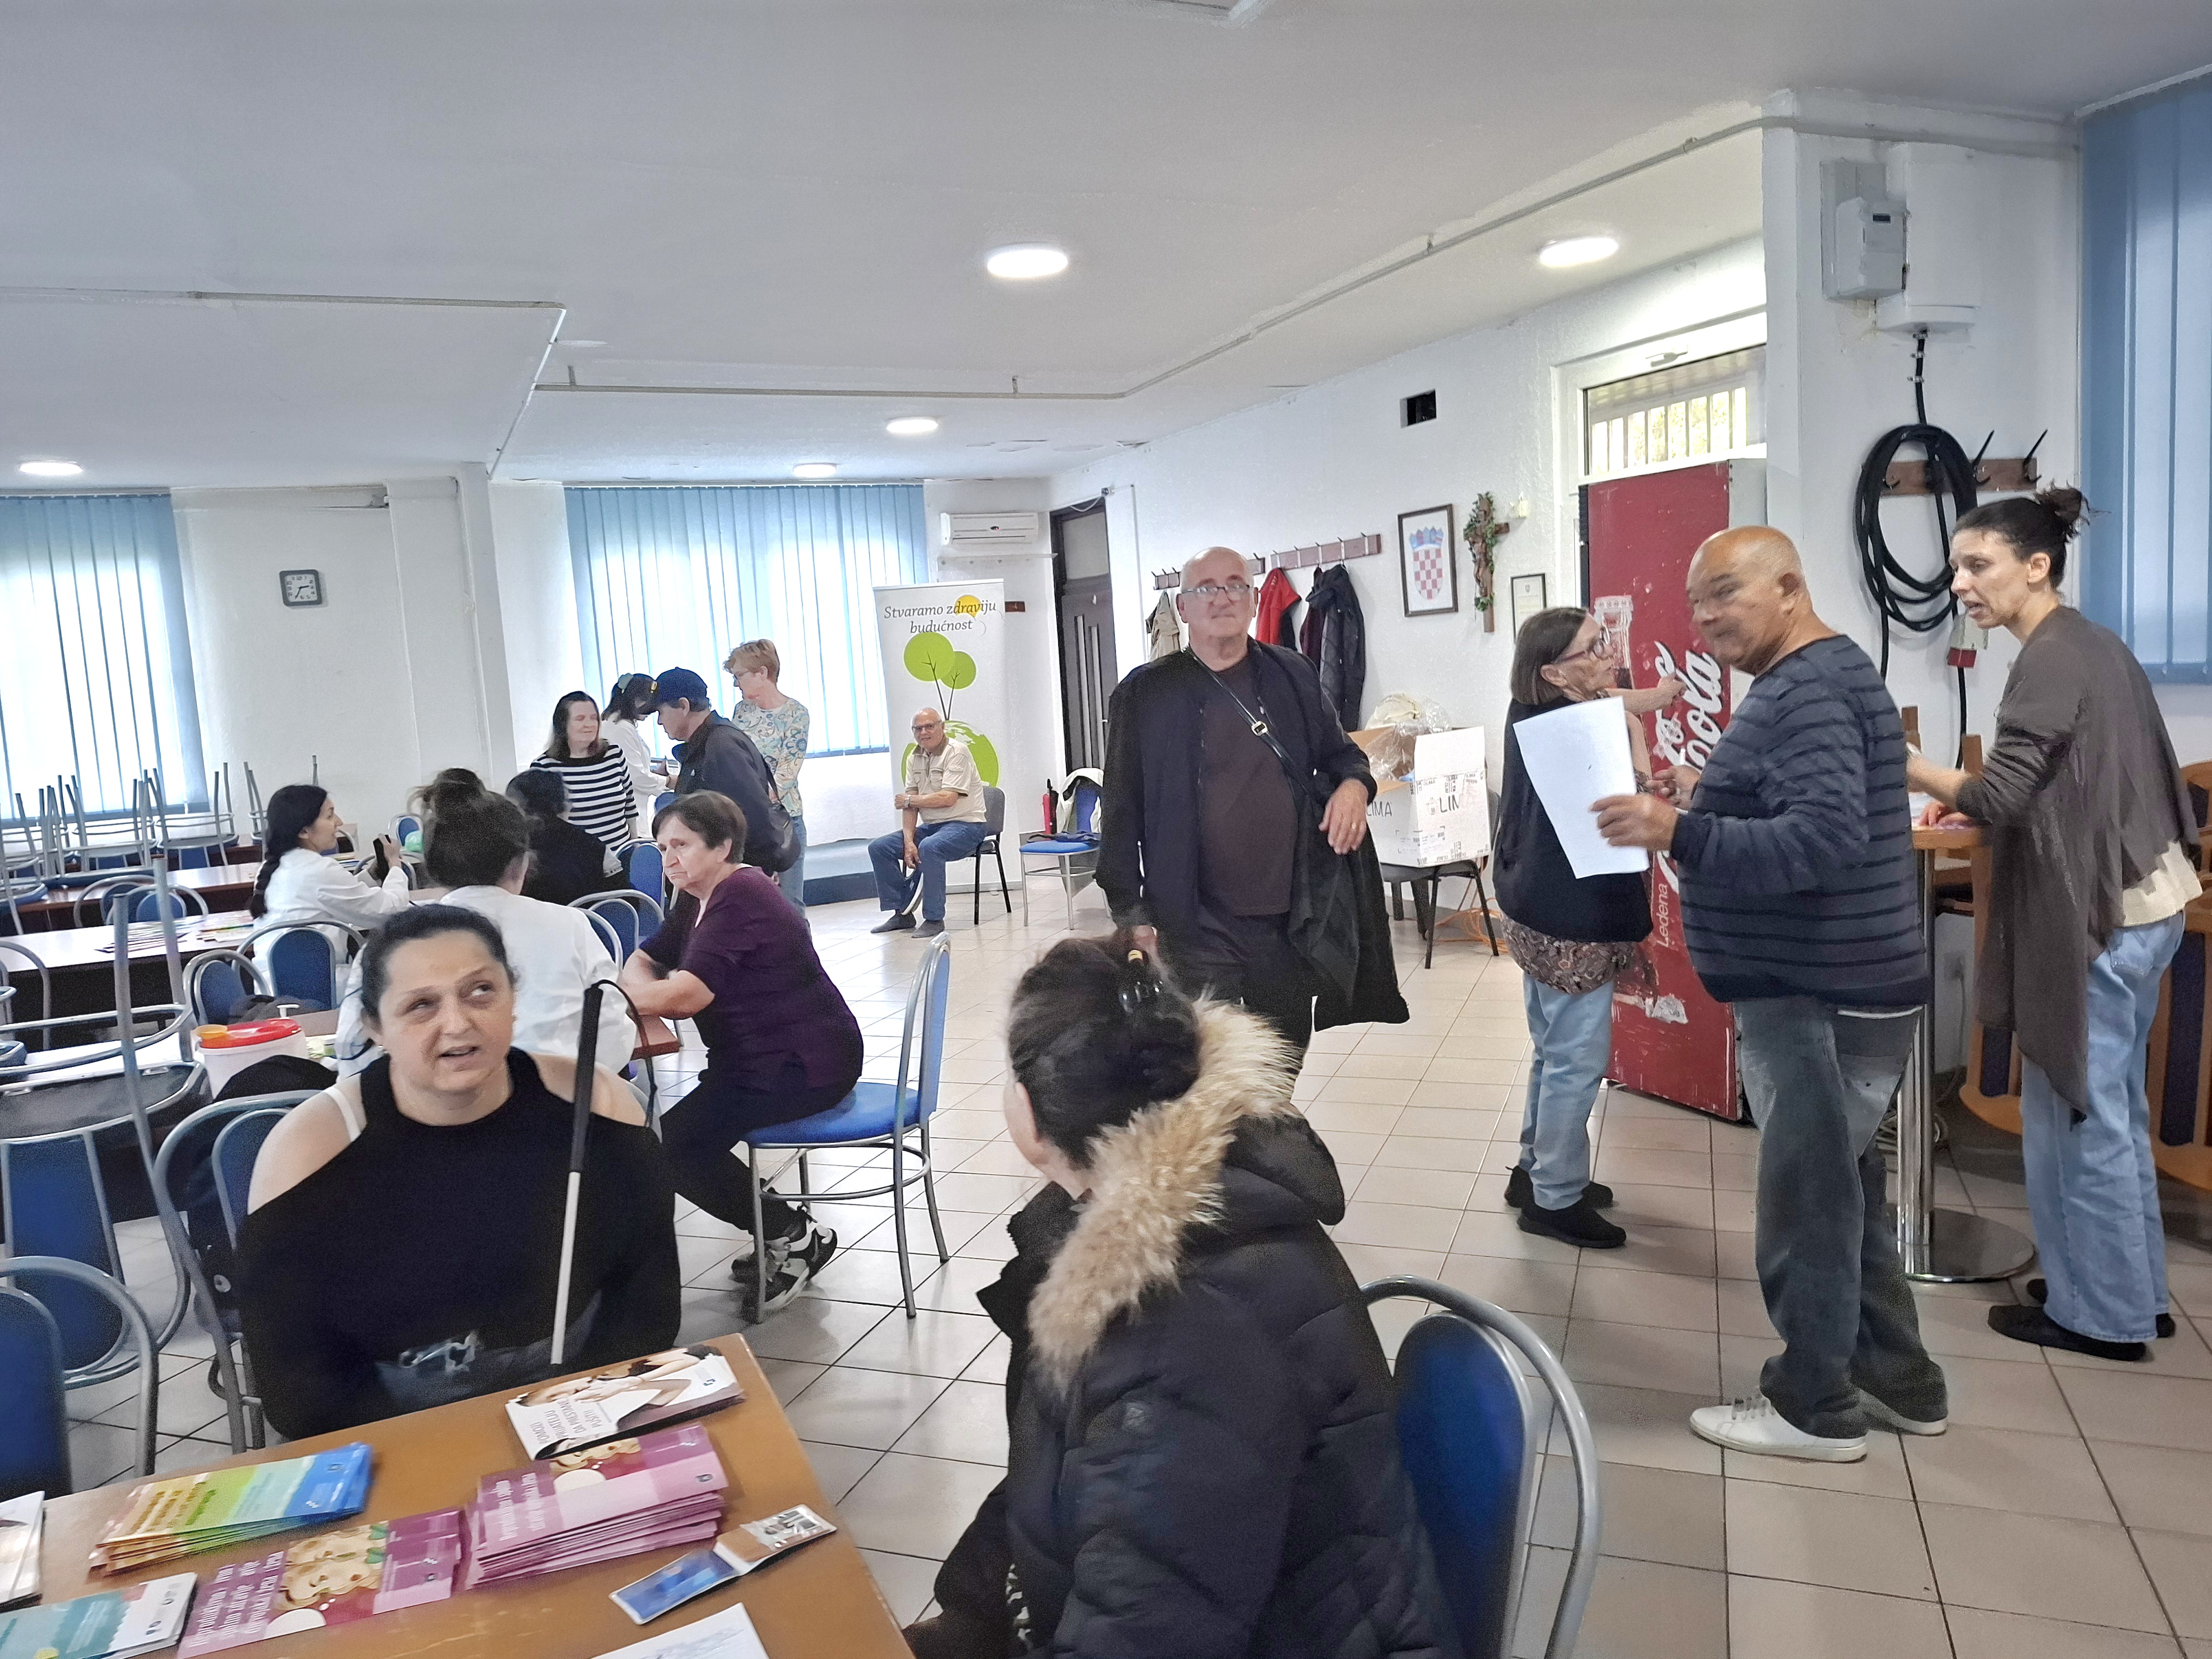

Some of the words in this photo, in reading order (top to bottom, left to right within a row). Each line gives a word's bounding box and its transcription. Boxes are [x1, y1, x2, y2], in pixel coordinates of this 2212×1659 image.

[884, 606, 943, 619] Stvaramo
[946, 600, 996, 615] zdraviju
[910, 619, 974, 634] budućnost
[1366, 800, 1392, 818] LIMA
[1656, 883, 1669, 948] Ledena
[530, 1422, 551, 1445] POMOZI
